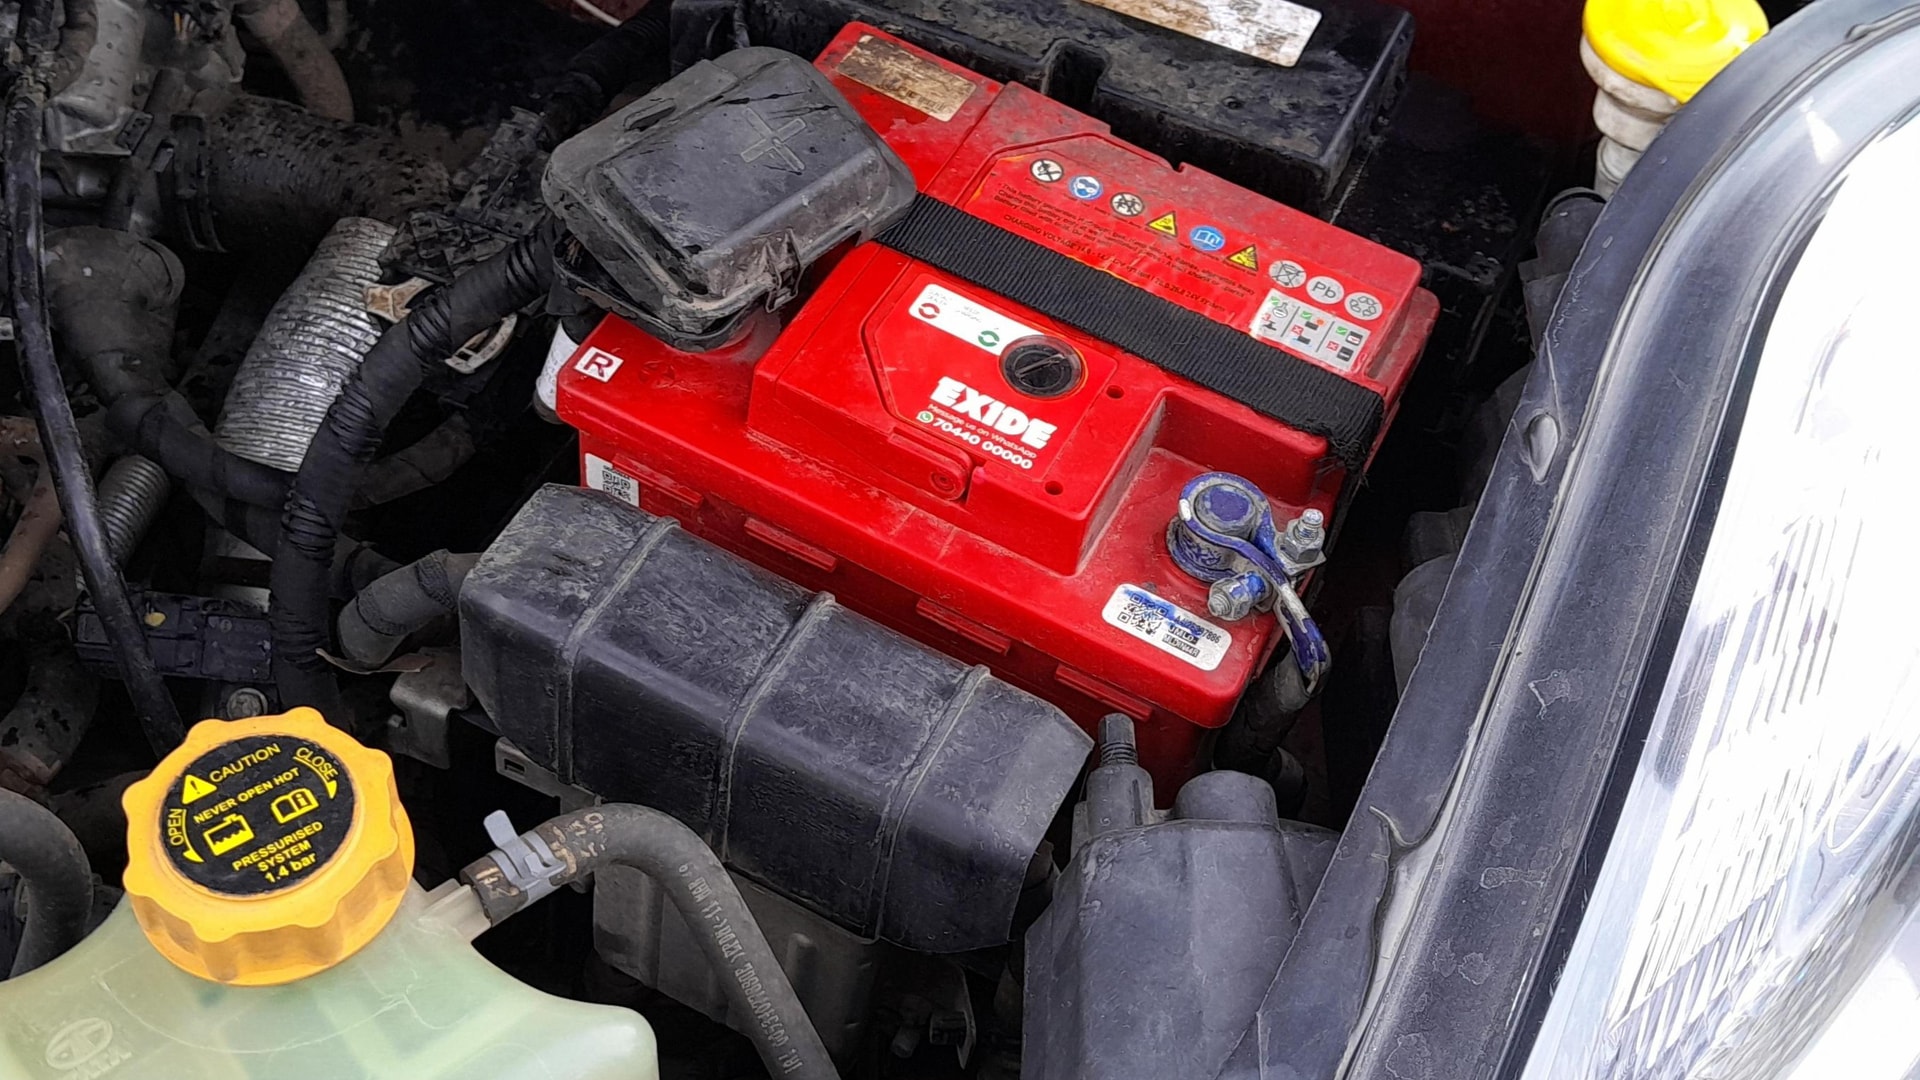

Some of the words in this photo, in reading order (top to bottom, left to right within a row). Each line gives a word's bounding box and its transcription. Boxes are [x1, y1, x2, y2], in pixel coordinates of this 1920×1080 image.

[1311, 281, 1337, 298] Pb
[583, 351, 614, 378] R
[928, 404, 964, 425] Message
[965, 422, 977, 431] us
[977, 427, 989, 437] on
[991, 432, 1037, 459] WhatsApp
[930, 376, 1058, 450] EXIDE
[933, 417, 981, 445] 70440
[981, 441, 1033, 469] 00000
[209, 743, 281, 783] CAUTION
[295, 747, 339, 781] CLOSE
[193, 798, 238, 824] NEVER
[237, 780, 274, 802] OPEN
[274, 767, 300, 786] HOT
[167, 808, 185, 846] OPEN
[231, 821, 324, 871] PRESSURISED
[257, 840, 312, 873] SYSTEM
[264, 865, 289, 883] 1.4
[290, 852, 317, 872] bar
